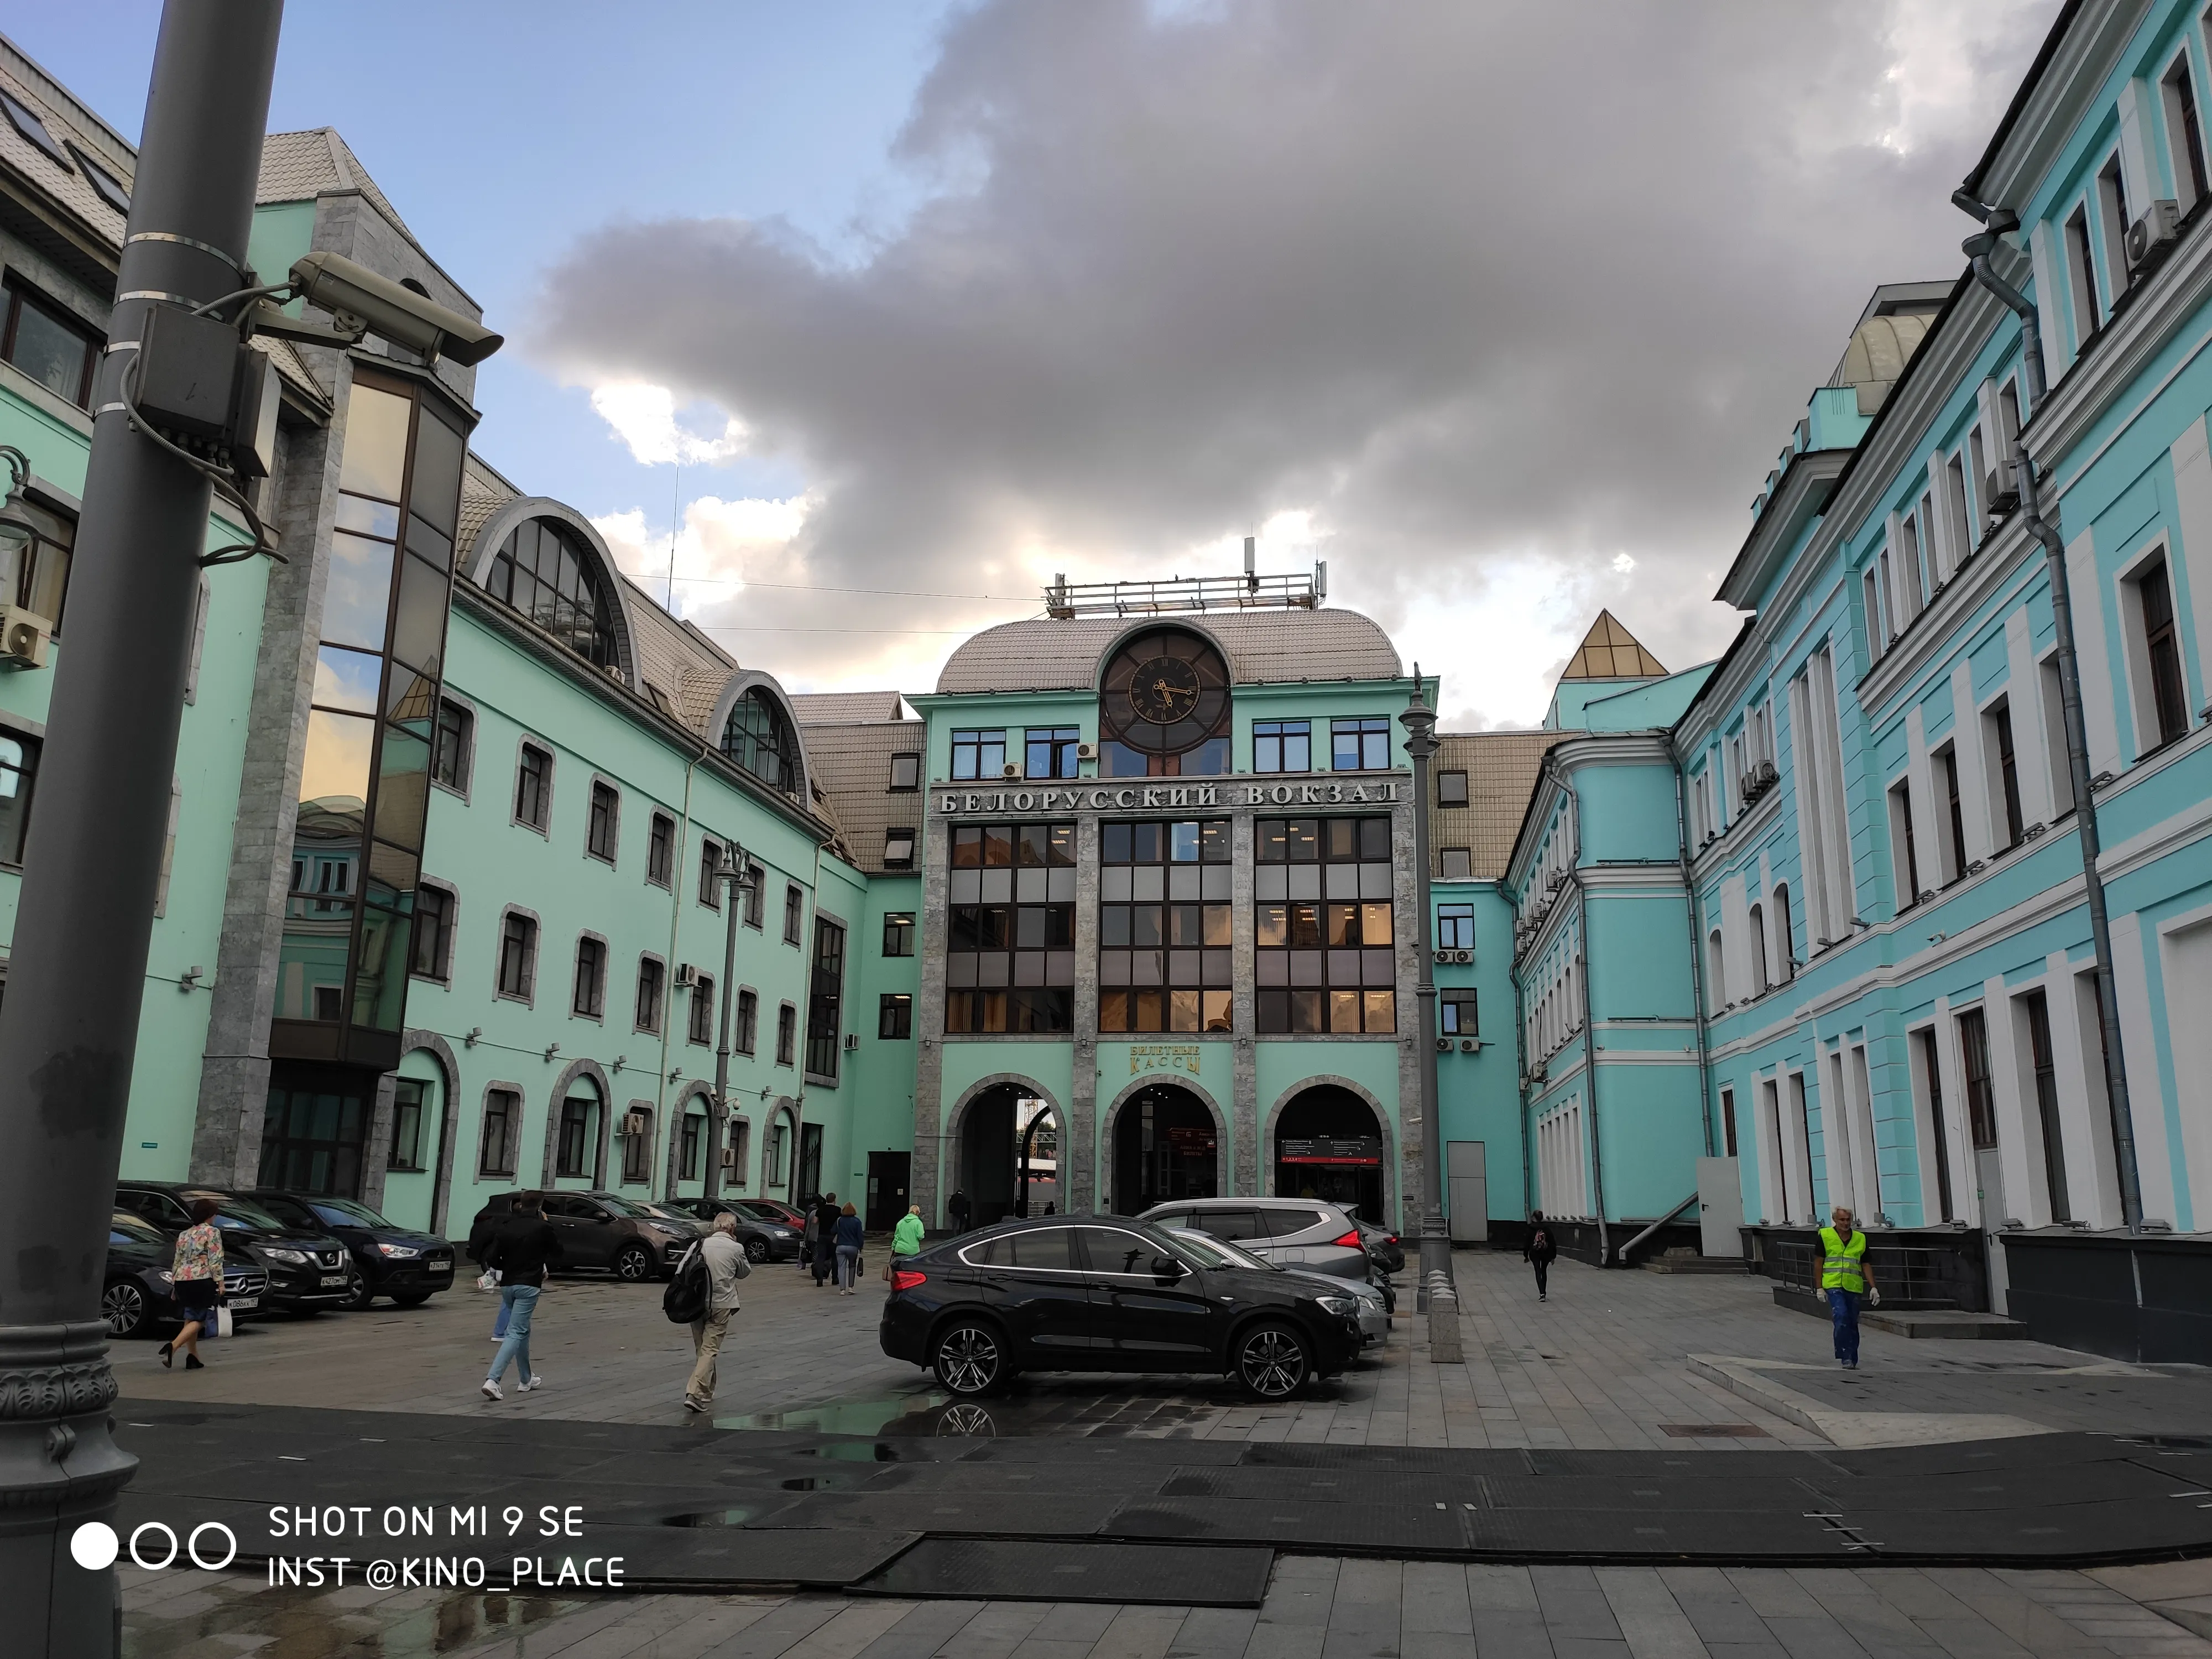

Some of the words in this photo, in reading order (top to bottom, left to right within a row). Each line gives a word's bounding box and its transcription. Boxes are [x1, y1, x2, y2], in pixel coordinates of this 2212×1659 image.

[940, 782, 1218, 812] БЕЛОРУССКИЙ
[1246, 782, 1399, 805] ВОКЗАЛ
[1130, 1046, 1200, 1055] БИЛЕТНЫЕ
[1130, 1057, 1200, 1075] КАССЫ
